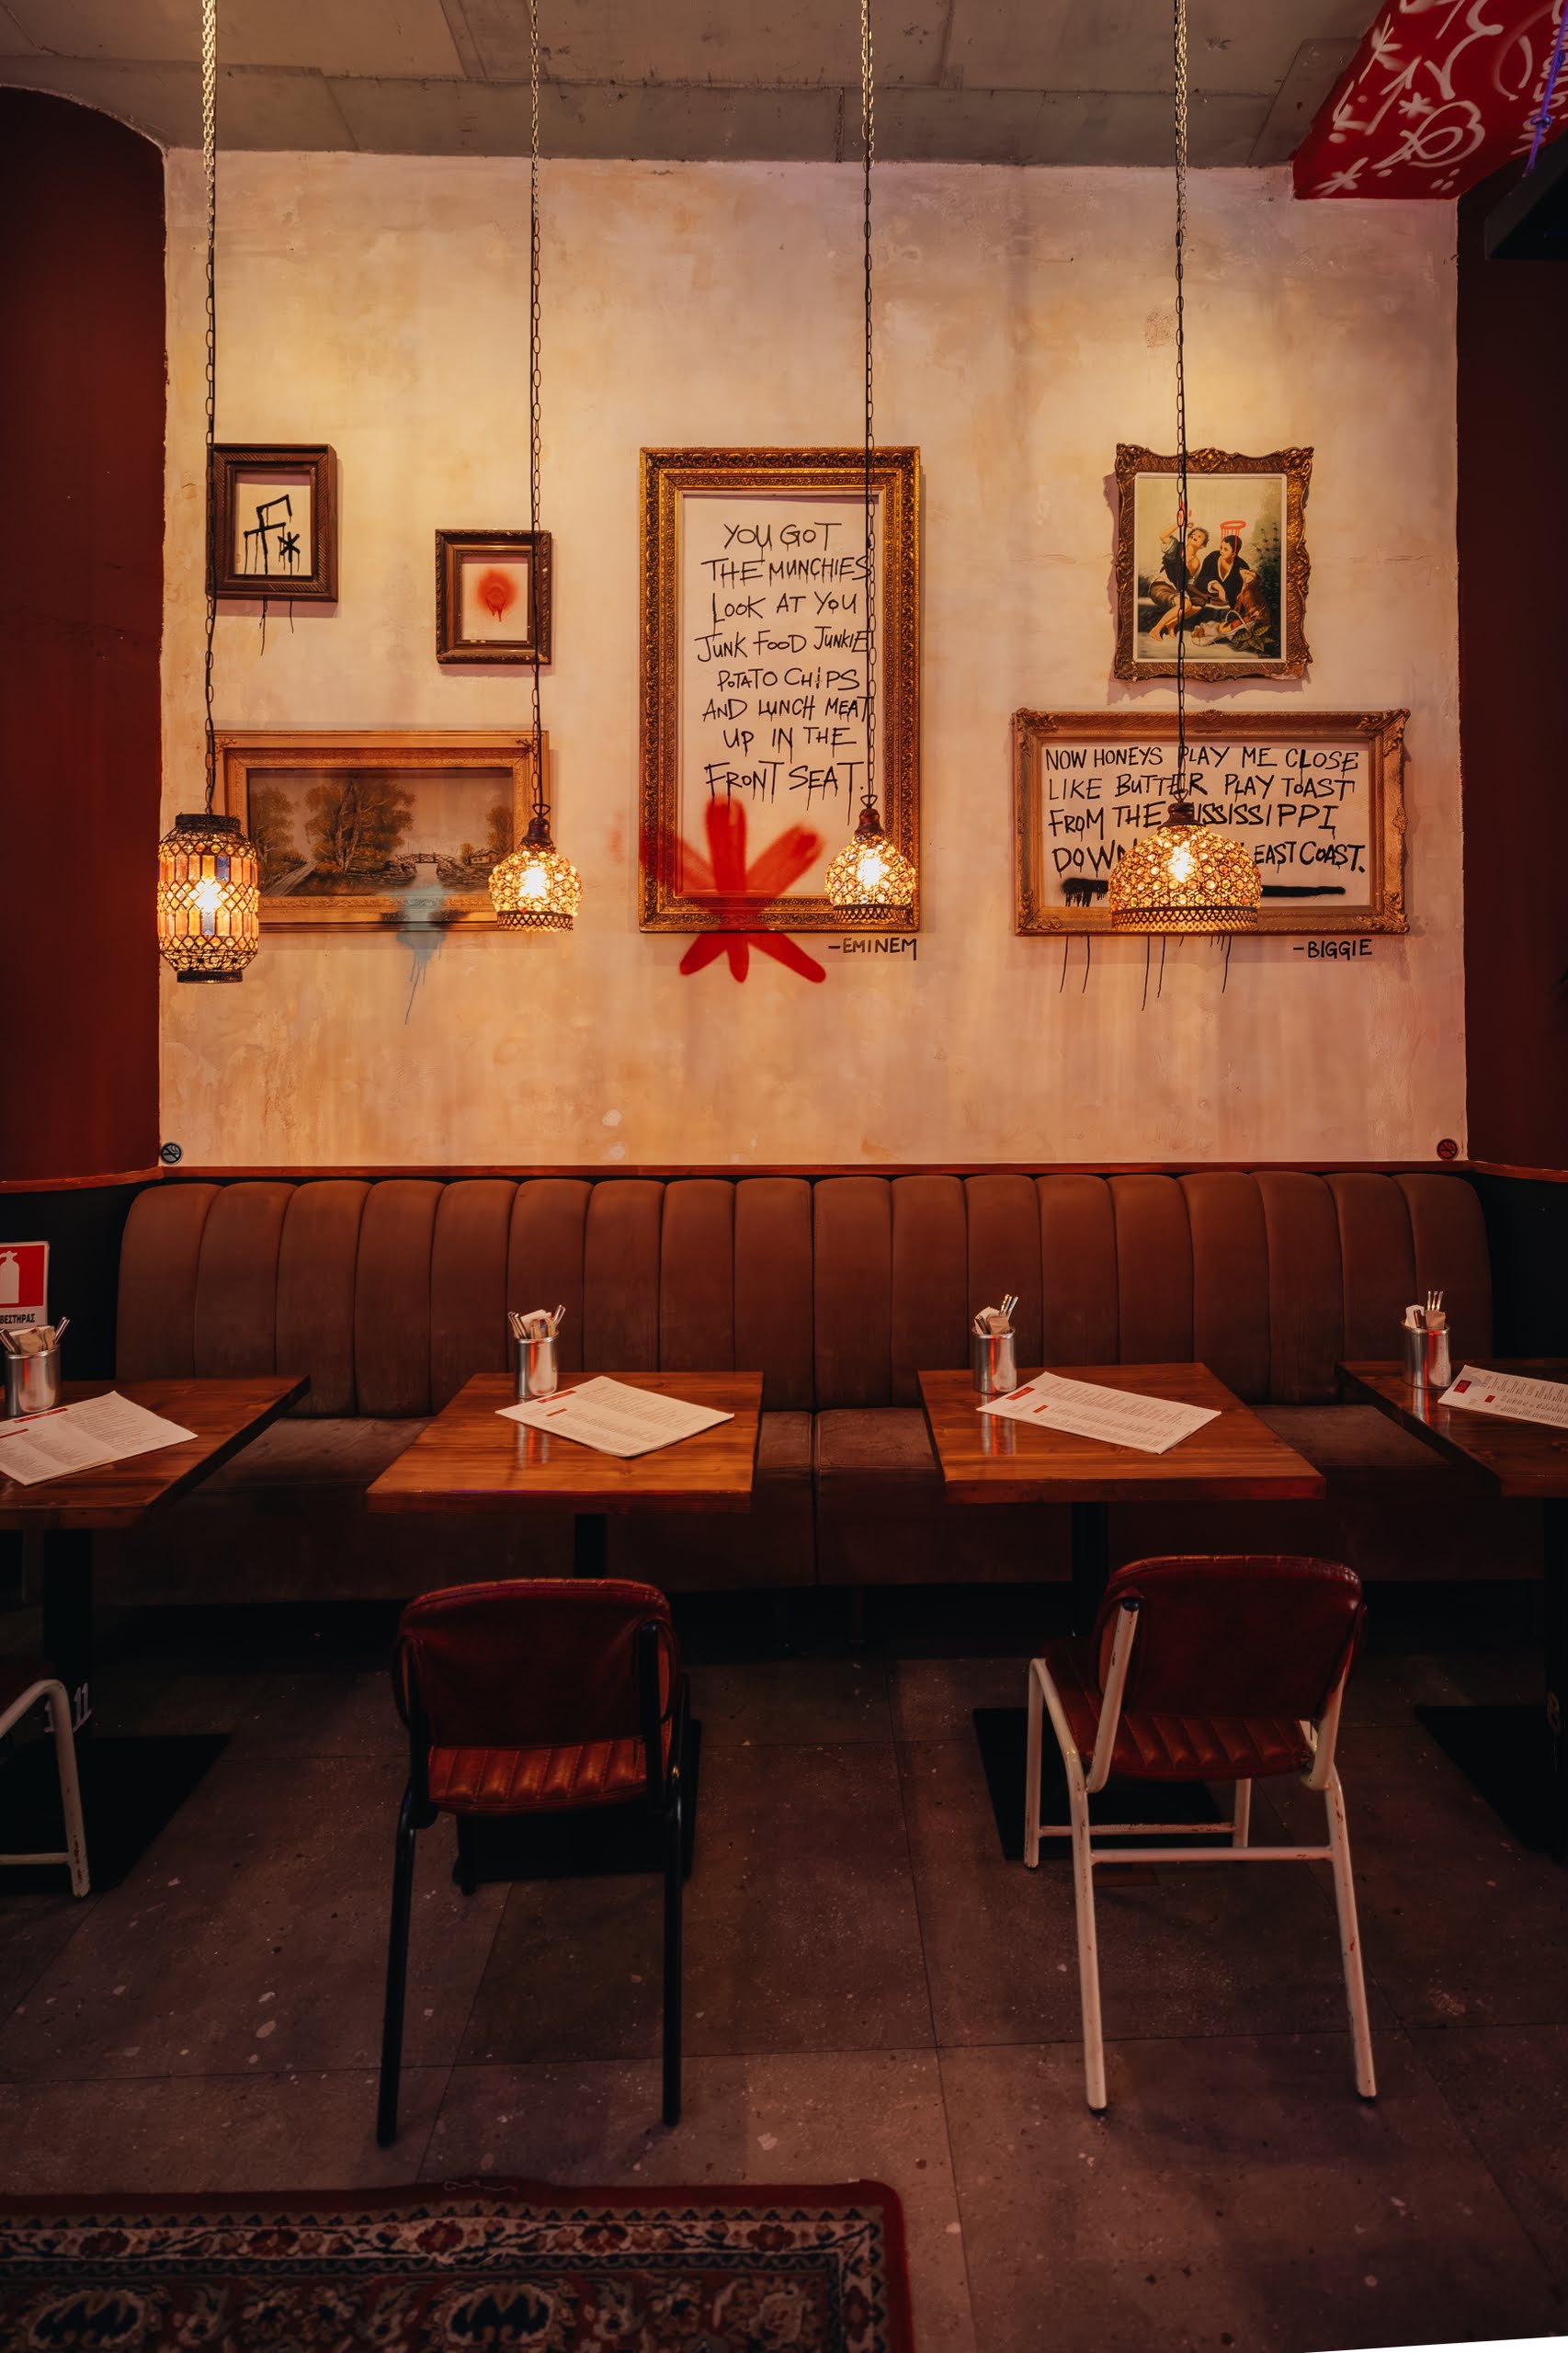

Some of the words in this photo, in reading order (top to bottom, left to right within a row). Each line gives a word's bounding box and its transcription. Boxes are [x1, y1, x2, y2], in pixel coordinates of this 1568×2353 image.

[723, 524, 772, 551] YOU
[779, 522, 842, 551] GOT
[701, 558, 766, 583] THE
[768, 555, 872, 582] MUNCHIES
[711, 593, 766, 623] LOOK
[777, 596, 806, 613] AT
[813, 591, 857, 615] YOU
[694, 631, 748, 663] JUNK
[753, 630, 807, 655] FOOD
[813, 626, 872, 654] JUNKIE
[717, 668, 778, 691] POTATO
[784, 667, 860, 690] CHIPS
[702, 699, 748, 722] AND
[758, 695, 815, 721] LUNCH
[825, 696, 872, 722] MEAT
[723, 729, 754, 753] UP
[772, 727, 793, 754] IN
[802, 727, 857, 748] THE
[1046, 749, 1086, 770] NOW
[1094, 746, 1163, 767] HONEYS
[1178, 745, 1230, 767] PLAY
[1242, 746, 1278, 767] ME
[1285, 748, 1358, 772] CLOSE
[704, 762, 784, 798] FRONT
[1049, 779, 1102, 800] LIKE
[1115, 773, 1208, 797] BUTTER
[1224, 774, 1275, 800] PLAY
[1281, 778, 1356, 801] TOAST
[1048, 807, 1104, 840] FROM
[1112, 801, 1166, 828] THE
[1196, 802, 1339, 830] ISSISSIPPI
[1254, 841, 1297, 865] EAST
